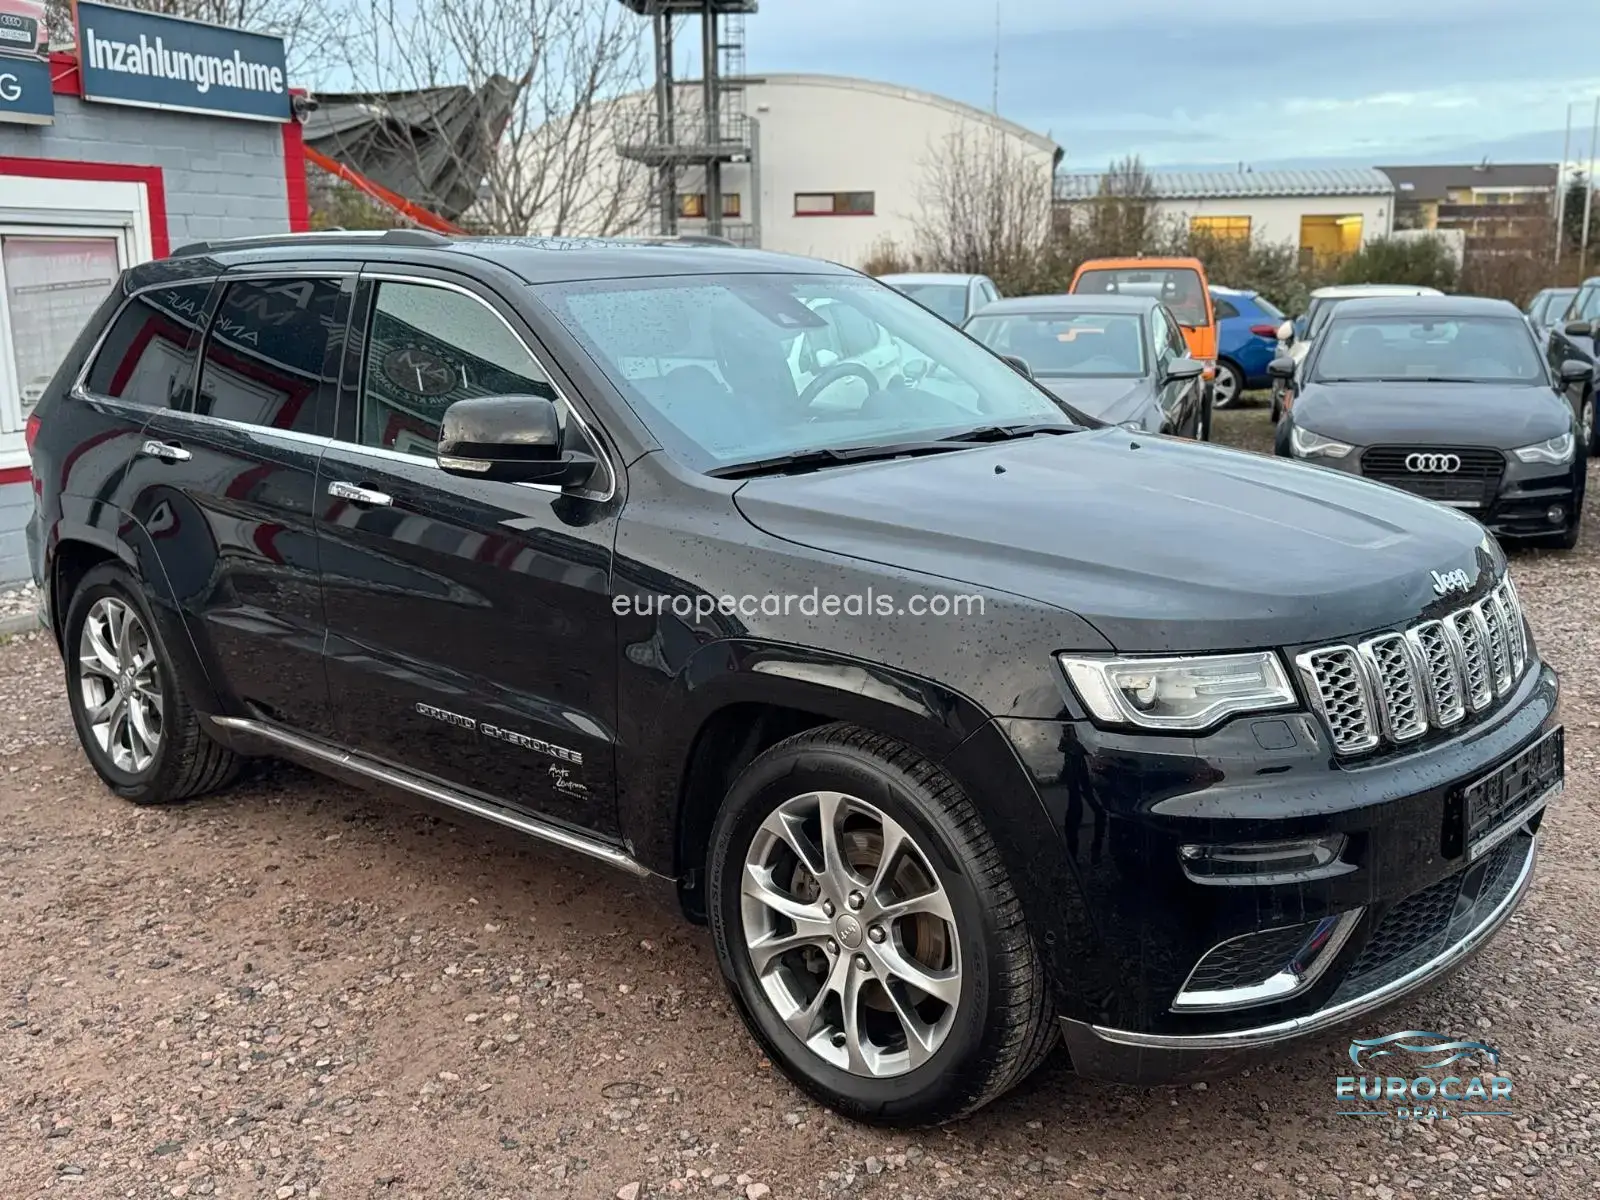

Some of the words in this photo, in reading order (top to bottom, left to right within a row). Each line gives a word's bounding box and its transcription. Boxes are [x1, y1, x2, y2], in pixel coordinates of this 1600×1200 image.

[86, 27, 284, 94] Inzahlungnahme
[1430, 568, 1471, 593] Jeep
[415, 702, 476, 730] GRAND
[480, 723, 583, 765] CHEROKEE
